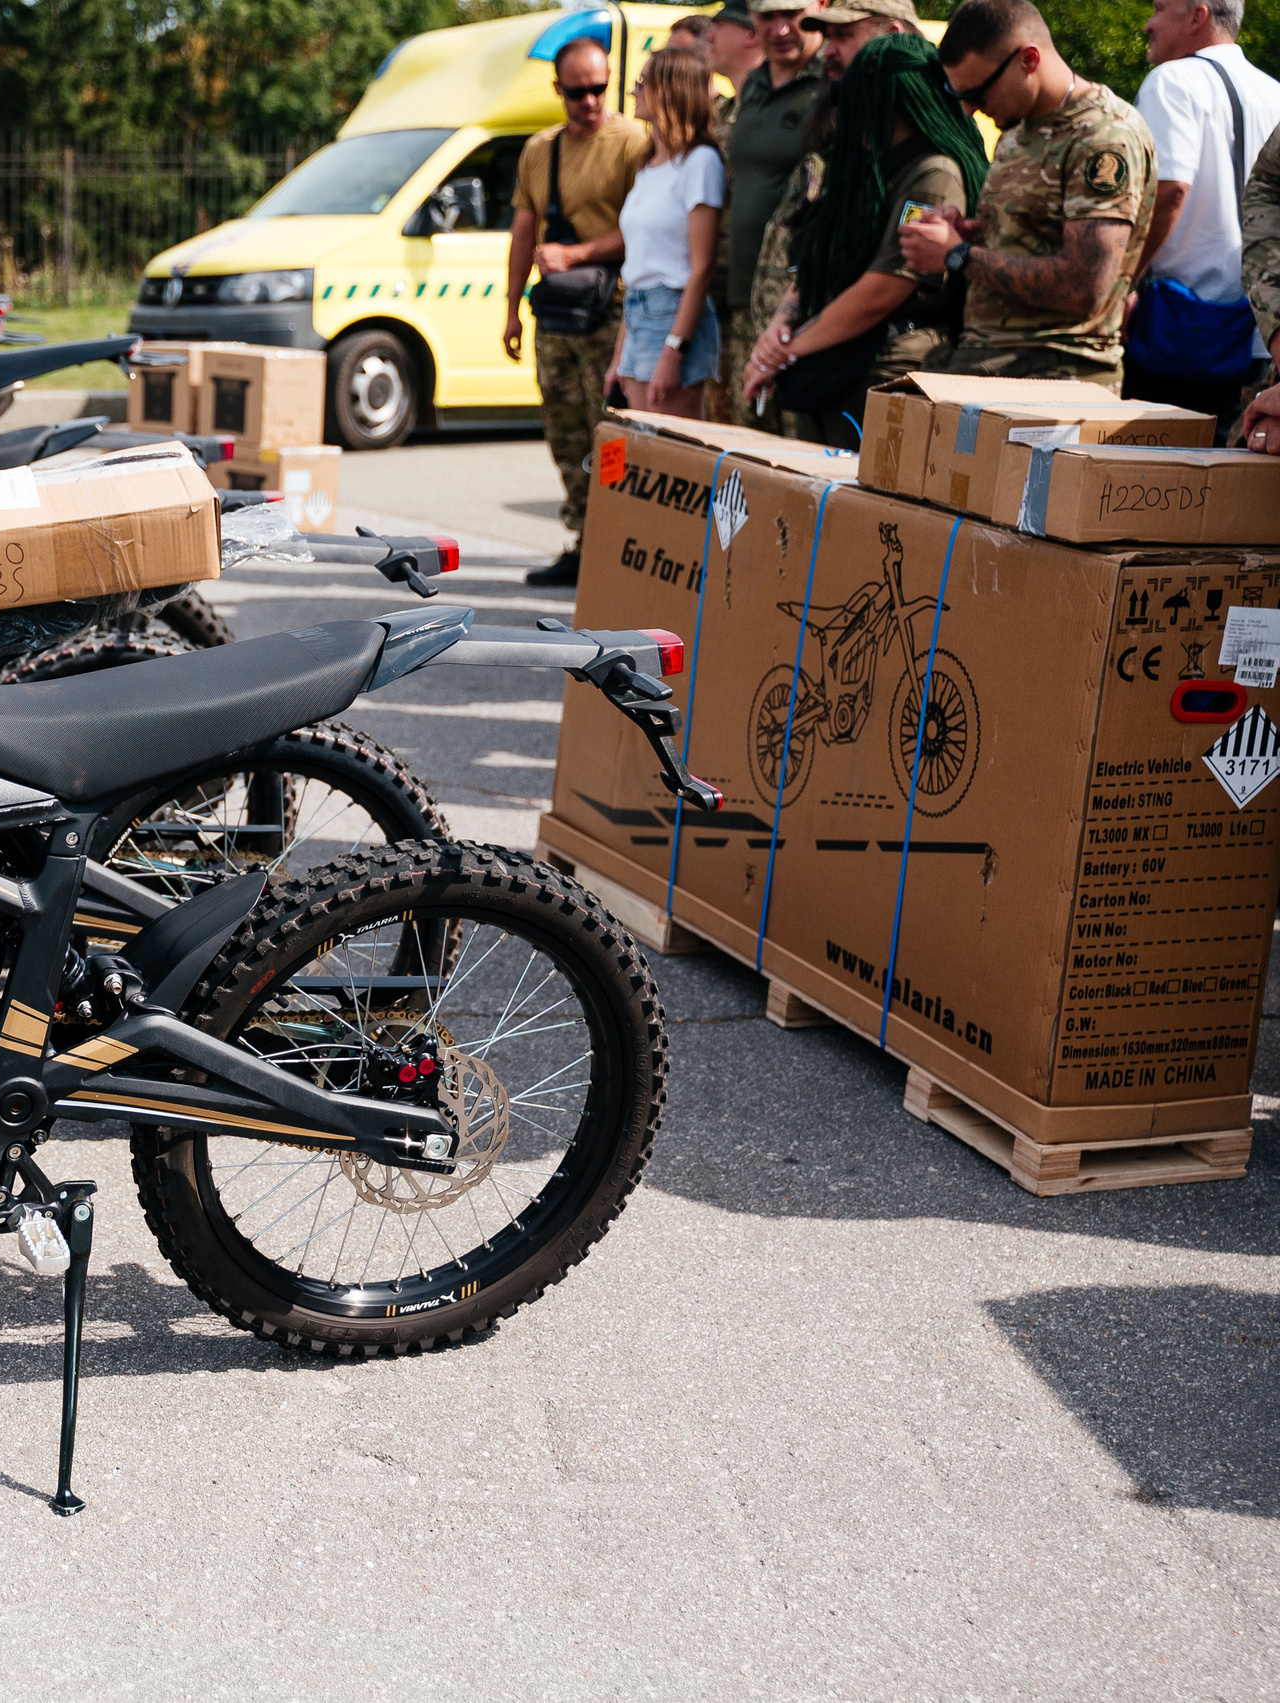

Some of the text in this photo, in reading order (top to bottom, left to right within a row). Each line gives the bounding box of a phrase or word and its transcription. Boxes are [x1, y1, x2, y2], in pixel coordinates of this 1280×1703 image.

[608, 463, 713, 521] ALARIA
[621, 537, 647, 572] Go
[650, 548, 684, 586] for
[1096, 757, 1192, 777] Electric Vehicle
[1224, 759, 1270, 776] 3171
[1092, 792, 1173, 811] Model: STING
[1088, 828, 1128, 844] TL3000
[1133, 827, 1150, 841] MX
[1187, 823, 1223, 838] TL3000
[1142, 858, 1166, 872] 60V
[1080, 891, 1151, 908] Carton No:
[356, 914, 399, 935] TALARIA
[1077, 922, 1127, 938] VIN No:
[1073, 952, 1138, 969] Motor No:
[1148, 981, 1166, 995] Red
[1182, 979, 1203, 993] Blue
[1219, 976, 1247, 990] Green
[1065, 1016, 1096, 1032] G.W:
[1061, 1043, 1119, 1060] Dimension:
[1085, 1063, 1217, 1090] MADE IN CHINA
[399, 1298, 440, 1314] TALARIA
